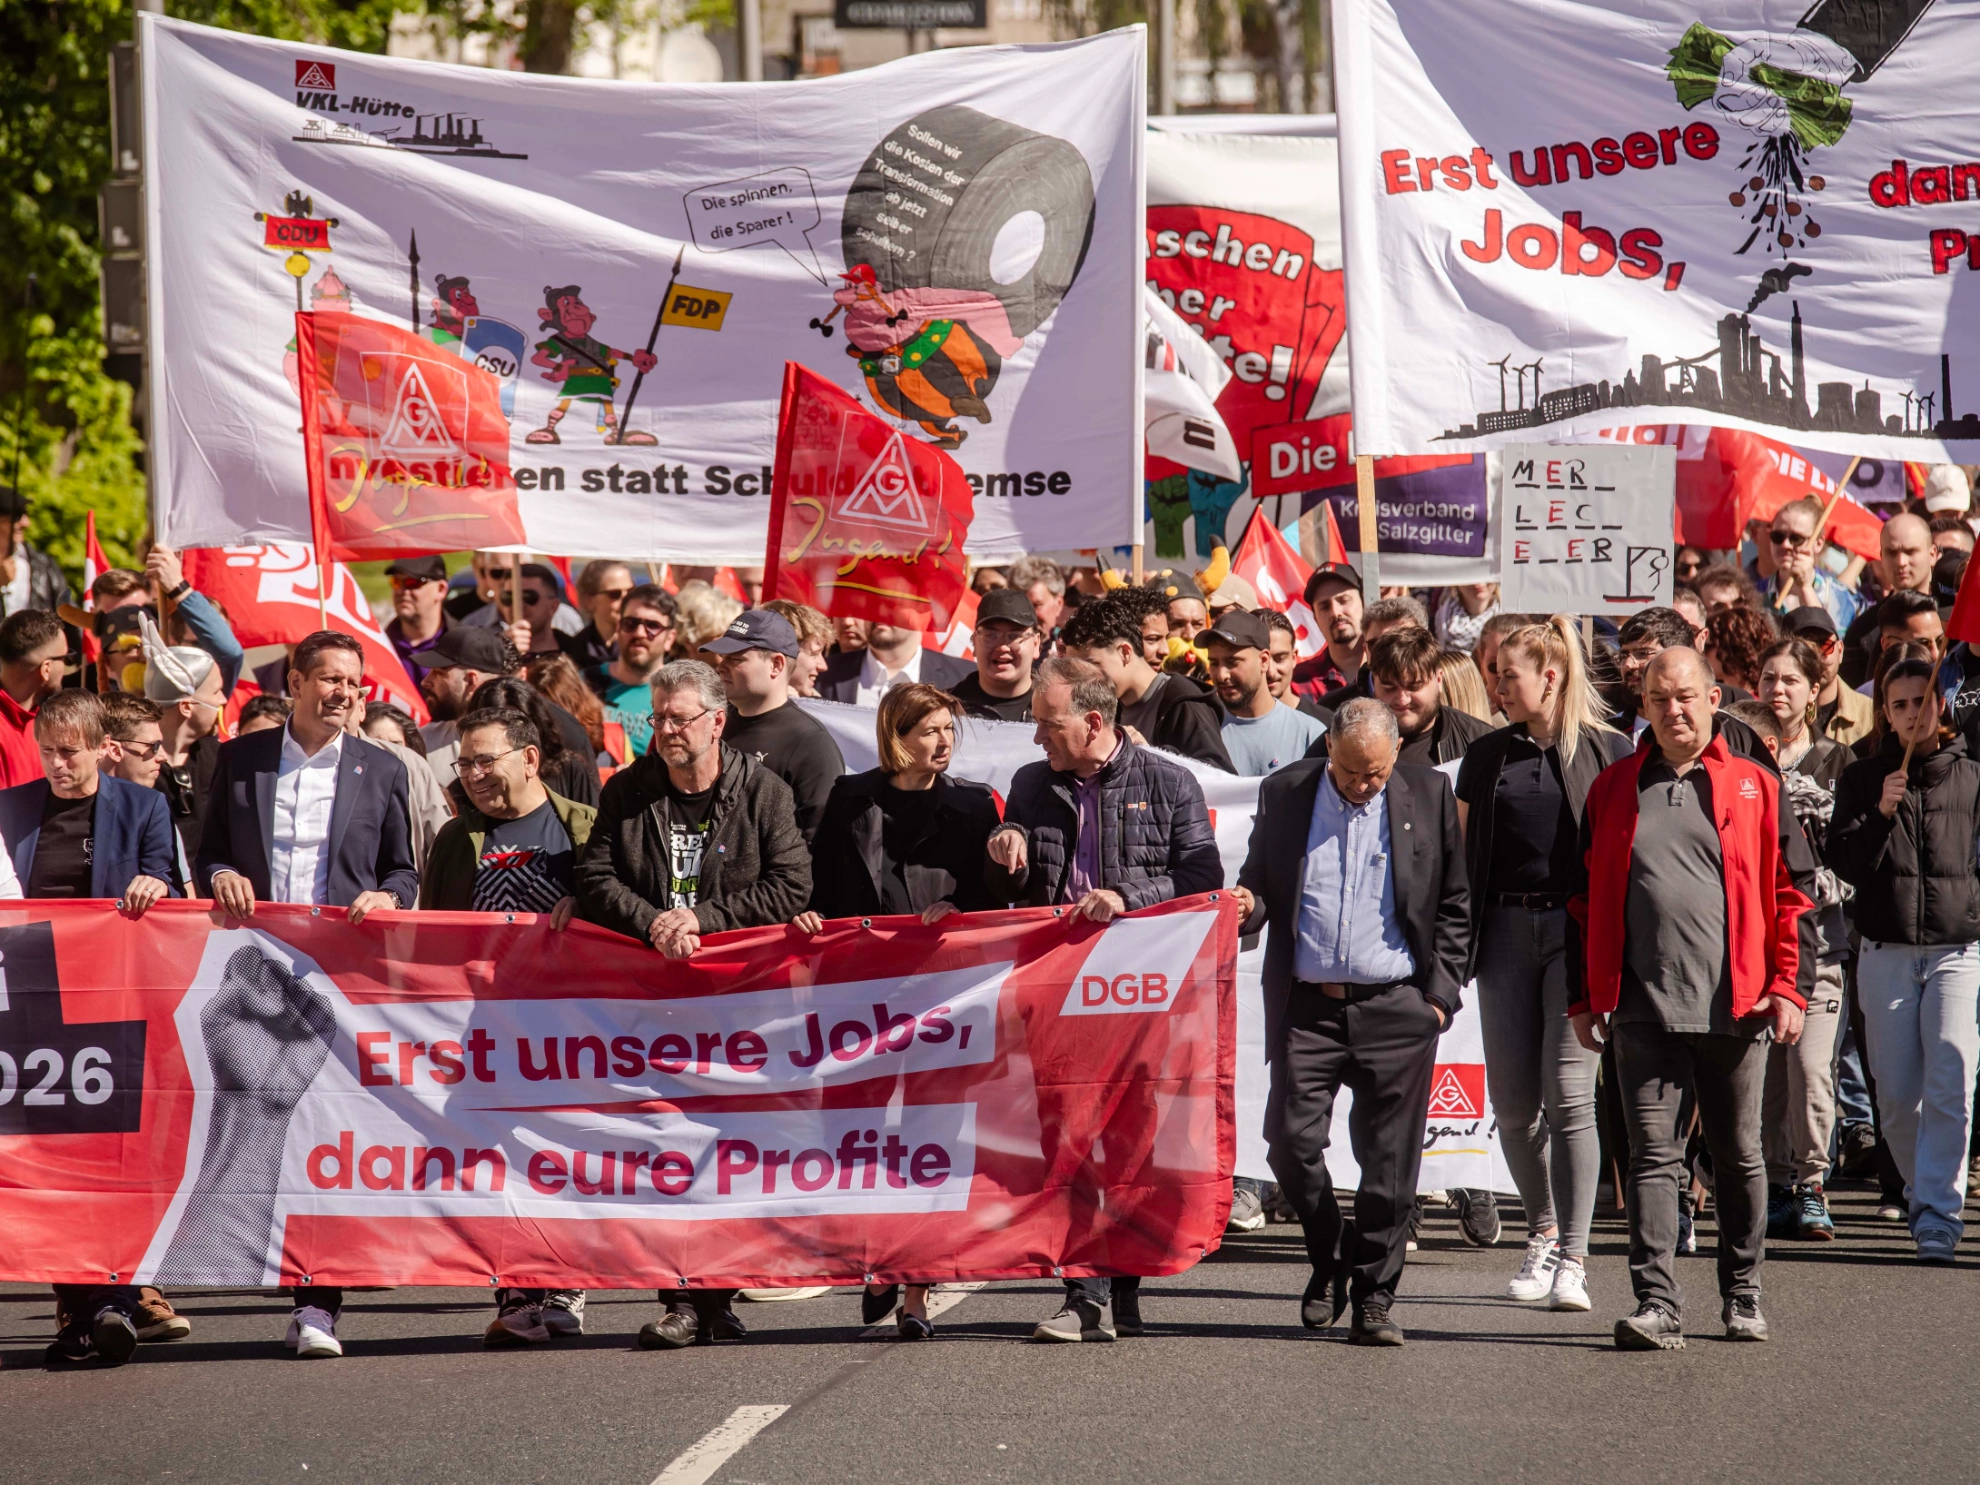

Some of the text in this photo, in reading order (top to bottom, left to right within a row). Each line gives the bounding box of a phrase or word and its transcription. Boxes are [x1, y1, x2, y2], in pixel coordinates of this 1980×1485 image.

[296, 91, 415, 118] VKL-Hütte
[908, 124, 963, 160] Sollen wir
[1380, 121, 1720, 195] Erst unsere
[884, 140, 965, 186] die Kosten der
[702, 183, 794, 212] Die spinnen,
[874, 157, 954, 206] Transformation
[885, 191, 927, 218] ab jetzt
[277, 224, 319, 243] CDU
[710, 224, 734, 241] die
[736, 214, 783, 238] Sparer
[876, 212, 913, 235] selber
[1146, 224, 1304, 281] schen
[1460, 208, 1686, 291] Jobs,
[671, 295, 720, 320] FDP
[474, 354, 516, 377] CSU
[1270, 436, 1337, 479] Die
[580, 462, 689, 495] statt
[1340, 499, 1475, 521] Krisverband
[1377, 522, 1474, 545] Salzgitter
[1082, 973, 1169, 1006] DGB
[356, 1002, 972, 1086] Erst unsere Jobs,
[306, 1128, 952, 1197] dann eure Profite
